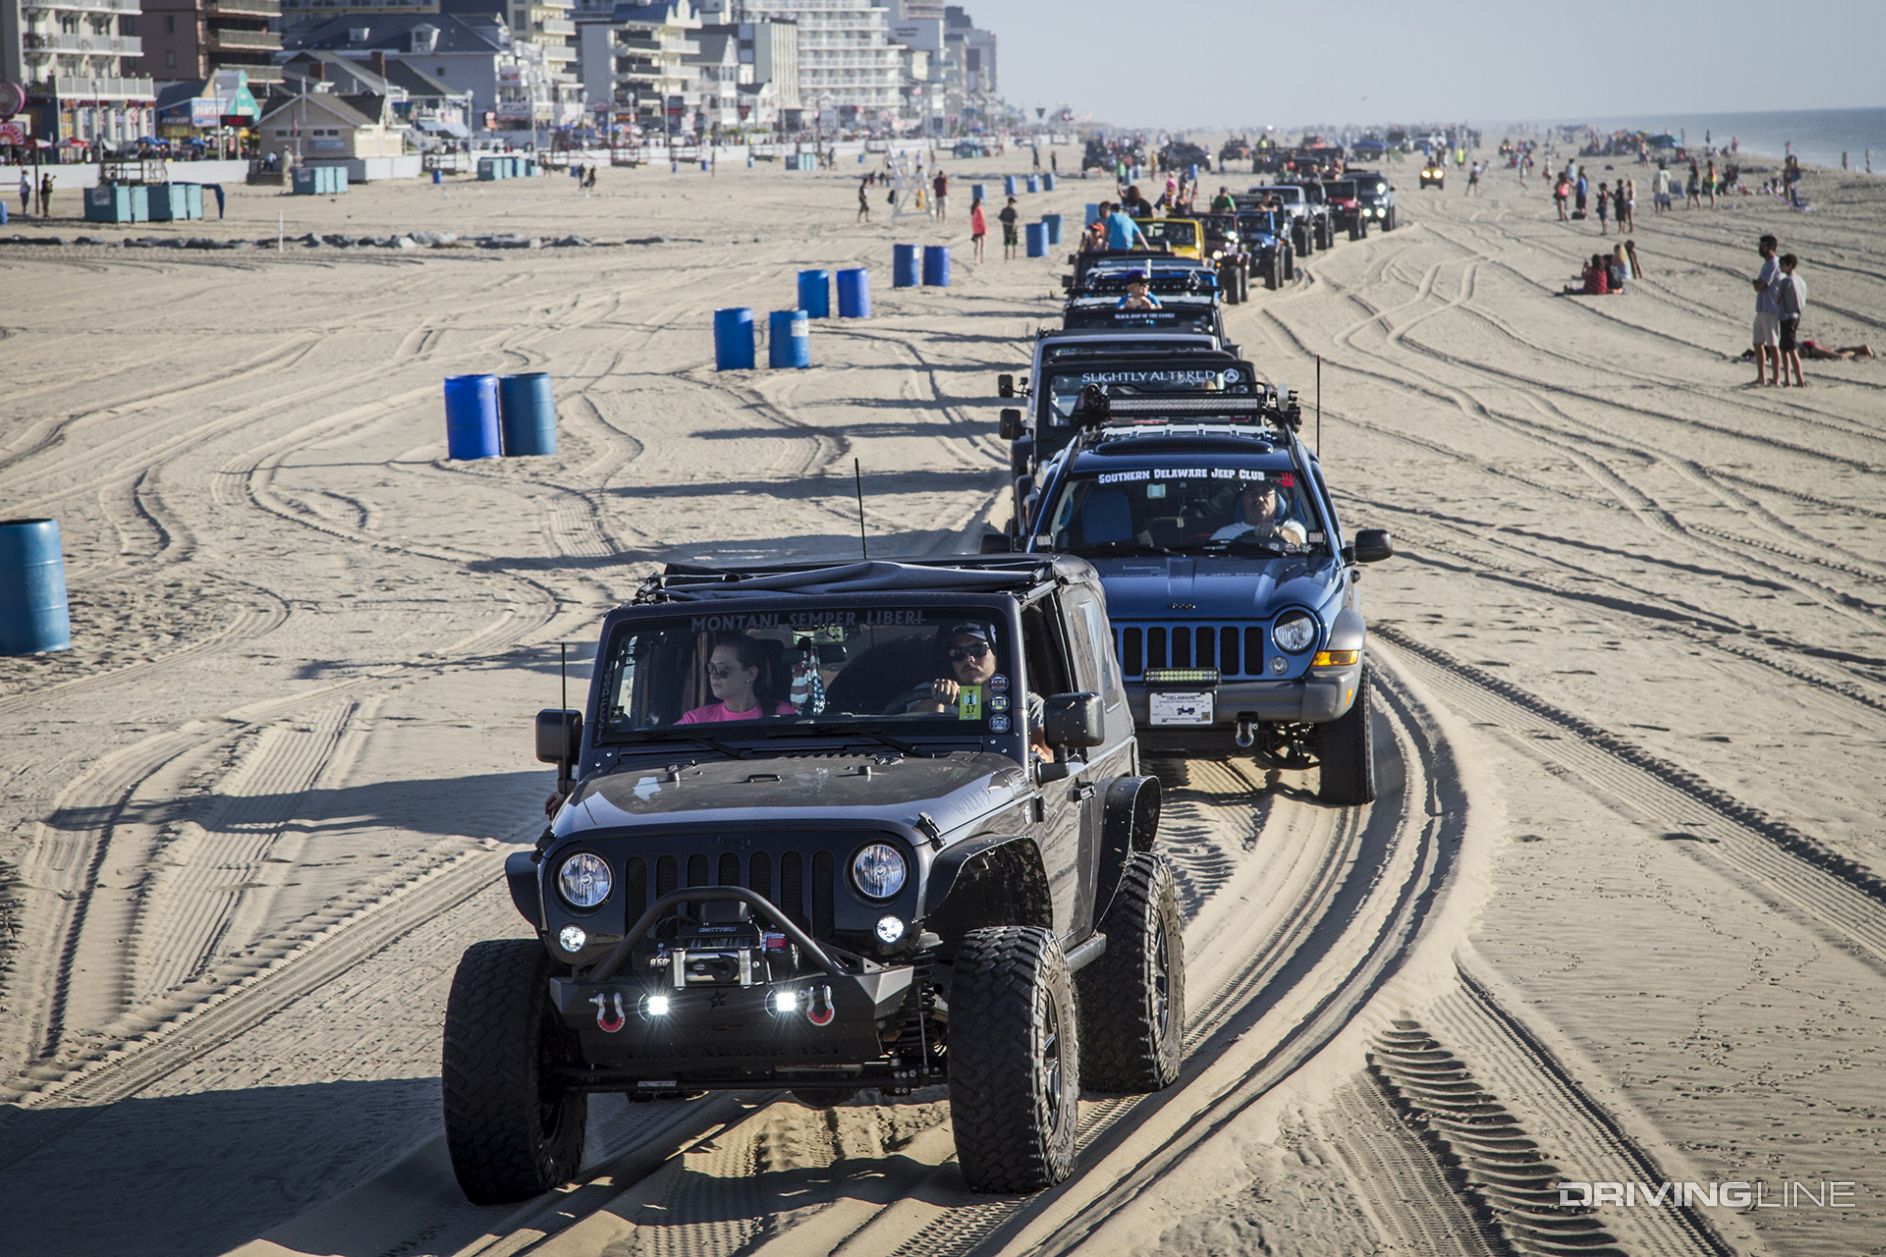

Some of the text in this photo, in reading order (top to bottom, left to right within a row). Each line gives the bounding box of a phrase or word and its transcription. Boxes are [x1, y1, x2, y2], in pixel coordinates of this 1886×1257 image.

[1081, 370, 1216, 383] SLIGHTLY ALTERED
[1098, 468, 1265, 484] SOUTHERN DELAWARE JEEP CLUB
[691, 609, 926, 633] MONTANI SEMPER LIBERI
[965, 705, 976, 714] 17
